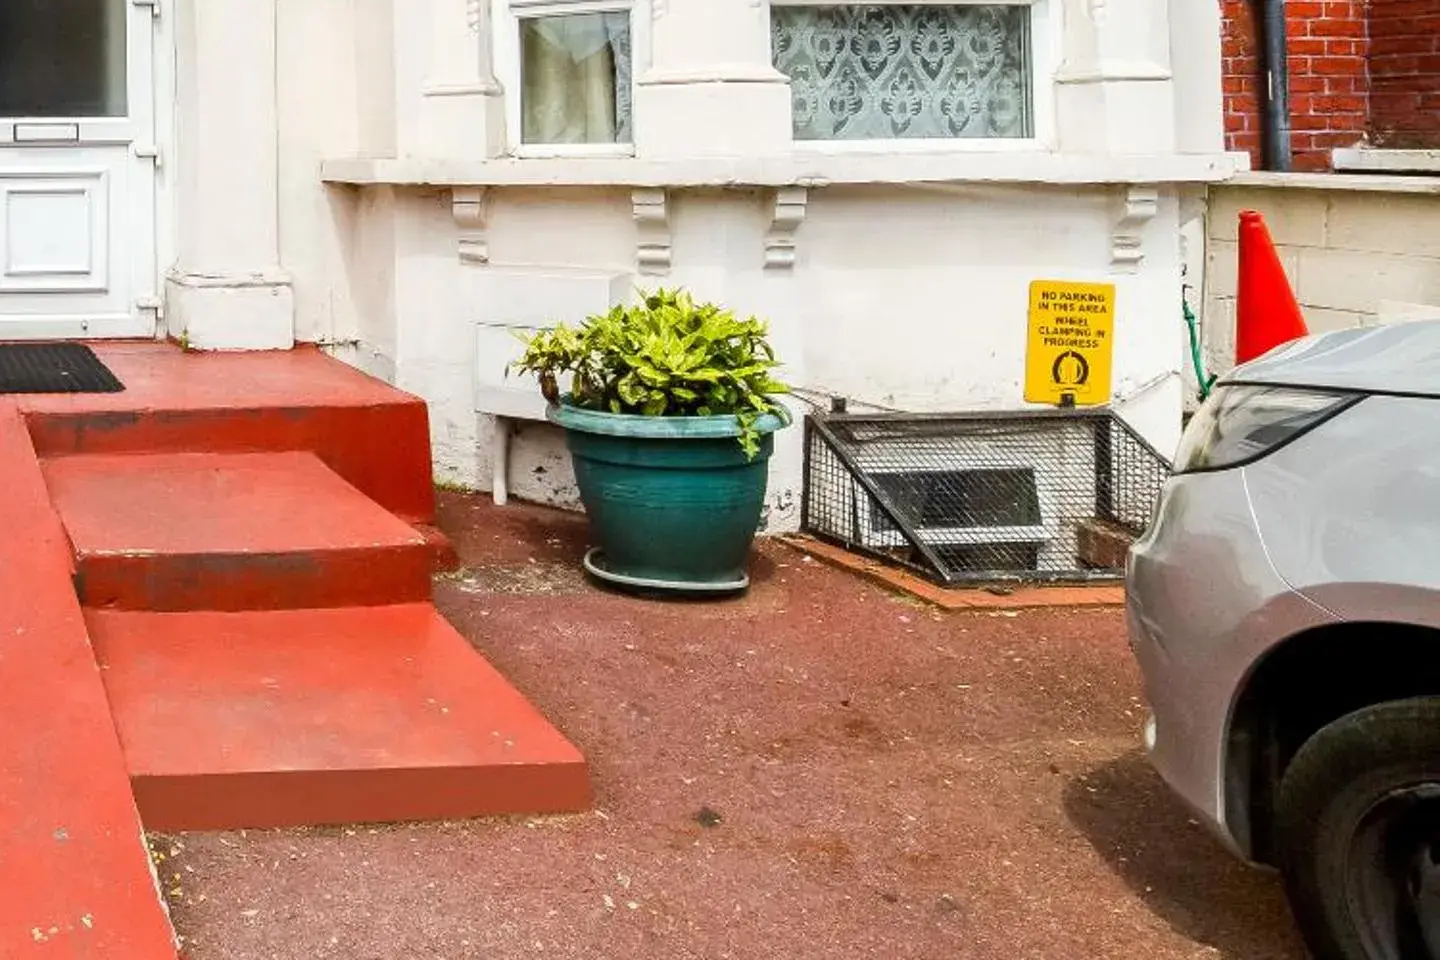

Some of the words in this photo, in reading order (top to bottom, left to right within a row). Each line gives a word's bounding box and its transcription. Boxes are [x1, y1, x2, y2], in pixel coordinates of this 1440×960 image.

[1042, 291, 1056, 300] NO
[1060, 292, 1105, 302] PARKING
[1039, 302, 1049, 310] IN
[1053, 303, 1075, 312] THIS
[1079, 304, 1107, 313] AREA
[1039, 326, 1091, 337] CLAMPING
[1044, 337, 1099, 348] PROGRESS
